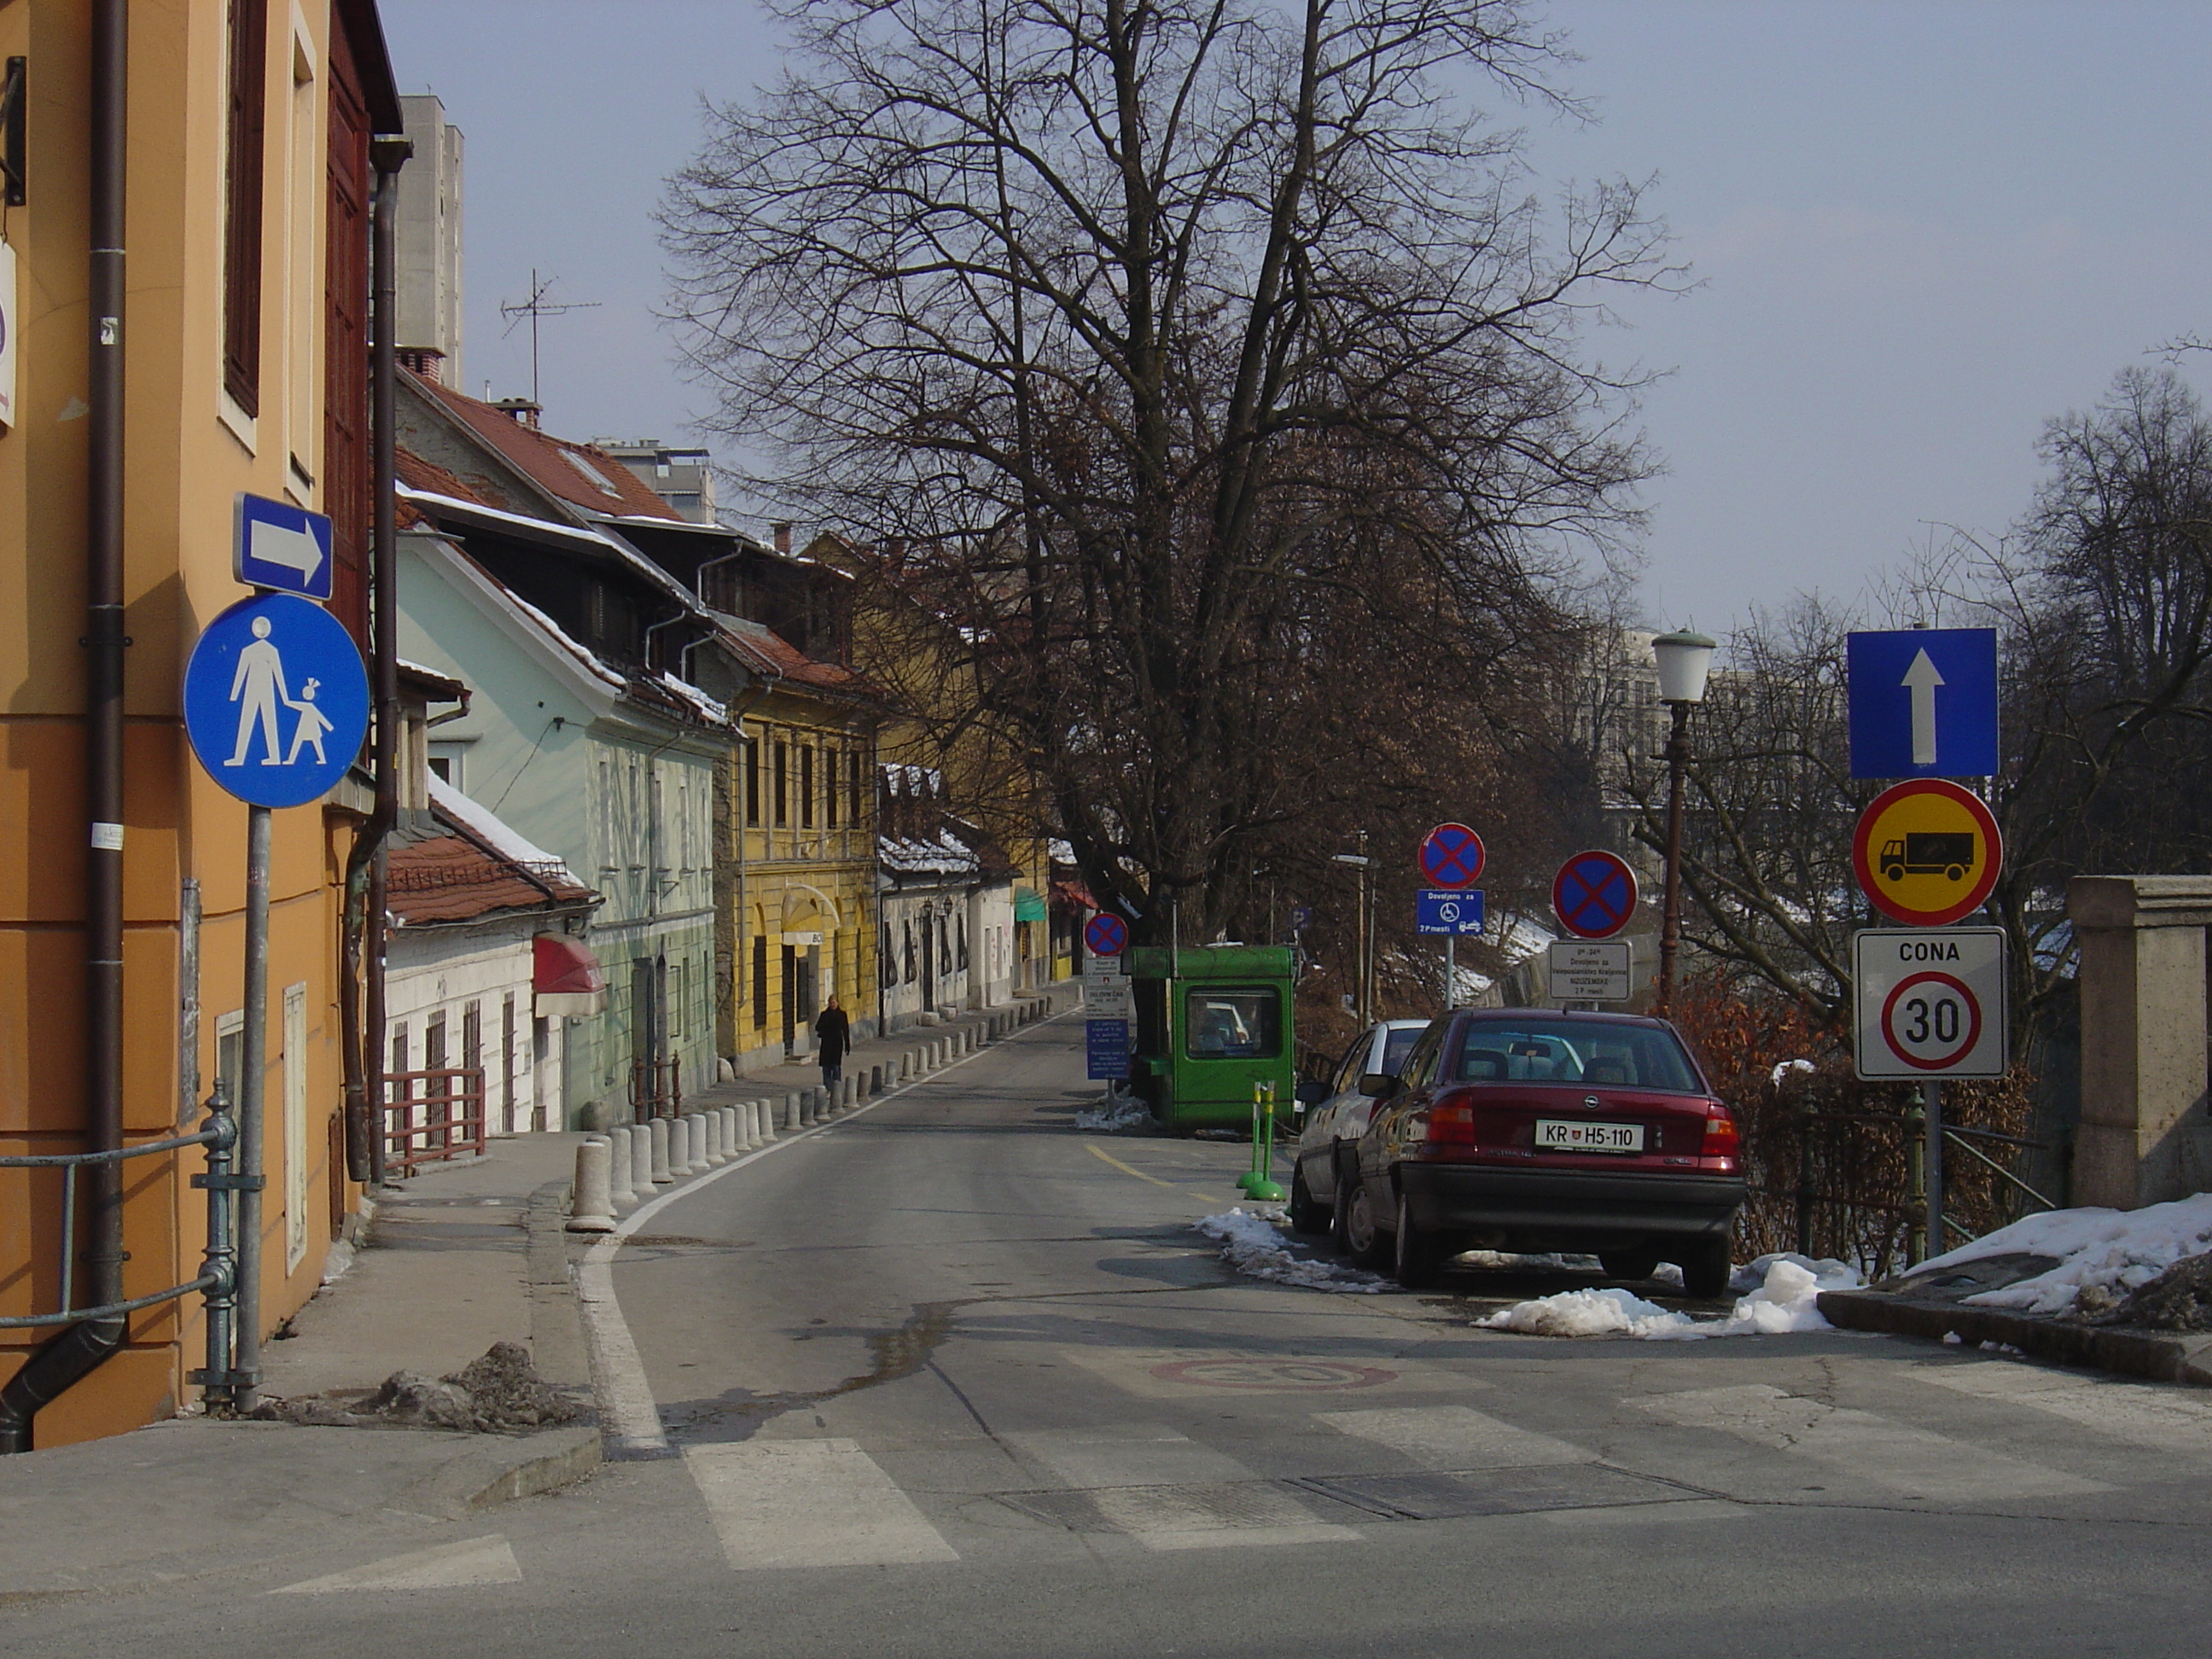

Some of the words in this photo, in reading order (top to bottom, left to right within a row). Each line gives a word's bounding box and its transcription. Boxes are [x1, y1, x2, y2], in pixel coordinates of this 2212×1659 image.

[1428, 892, 1461, 901] Dovoljeno
[1900, 942, 1960, 961] CONA
[1906, 998, 1959, 1044] 30
[1545, 1125, 1568, 1143] KR
[1585, 1126, 1633, 1145] H5-110
[1196, 1366, 1348, 1382] 30
